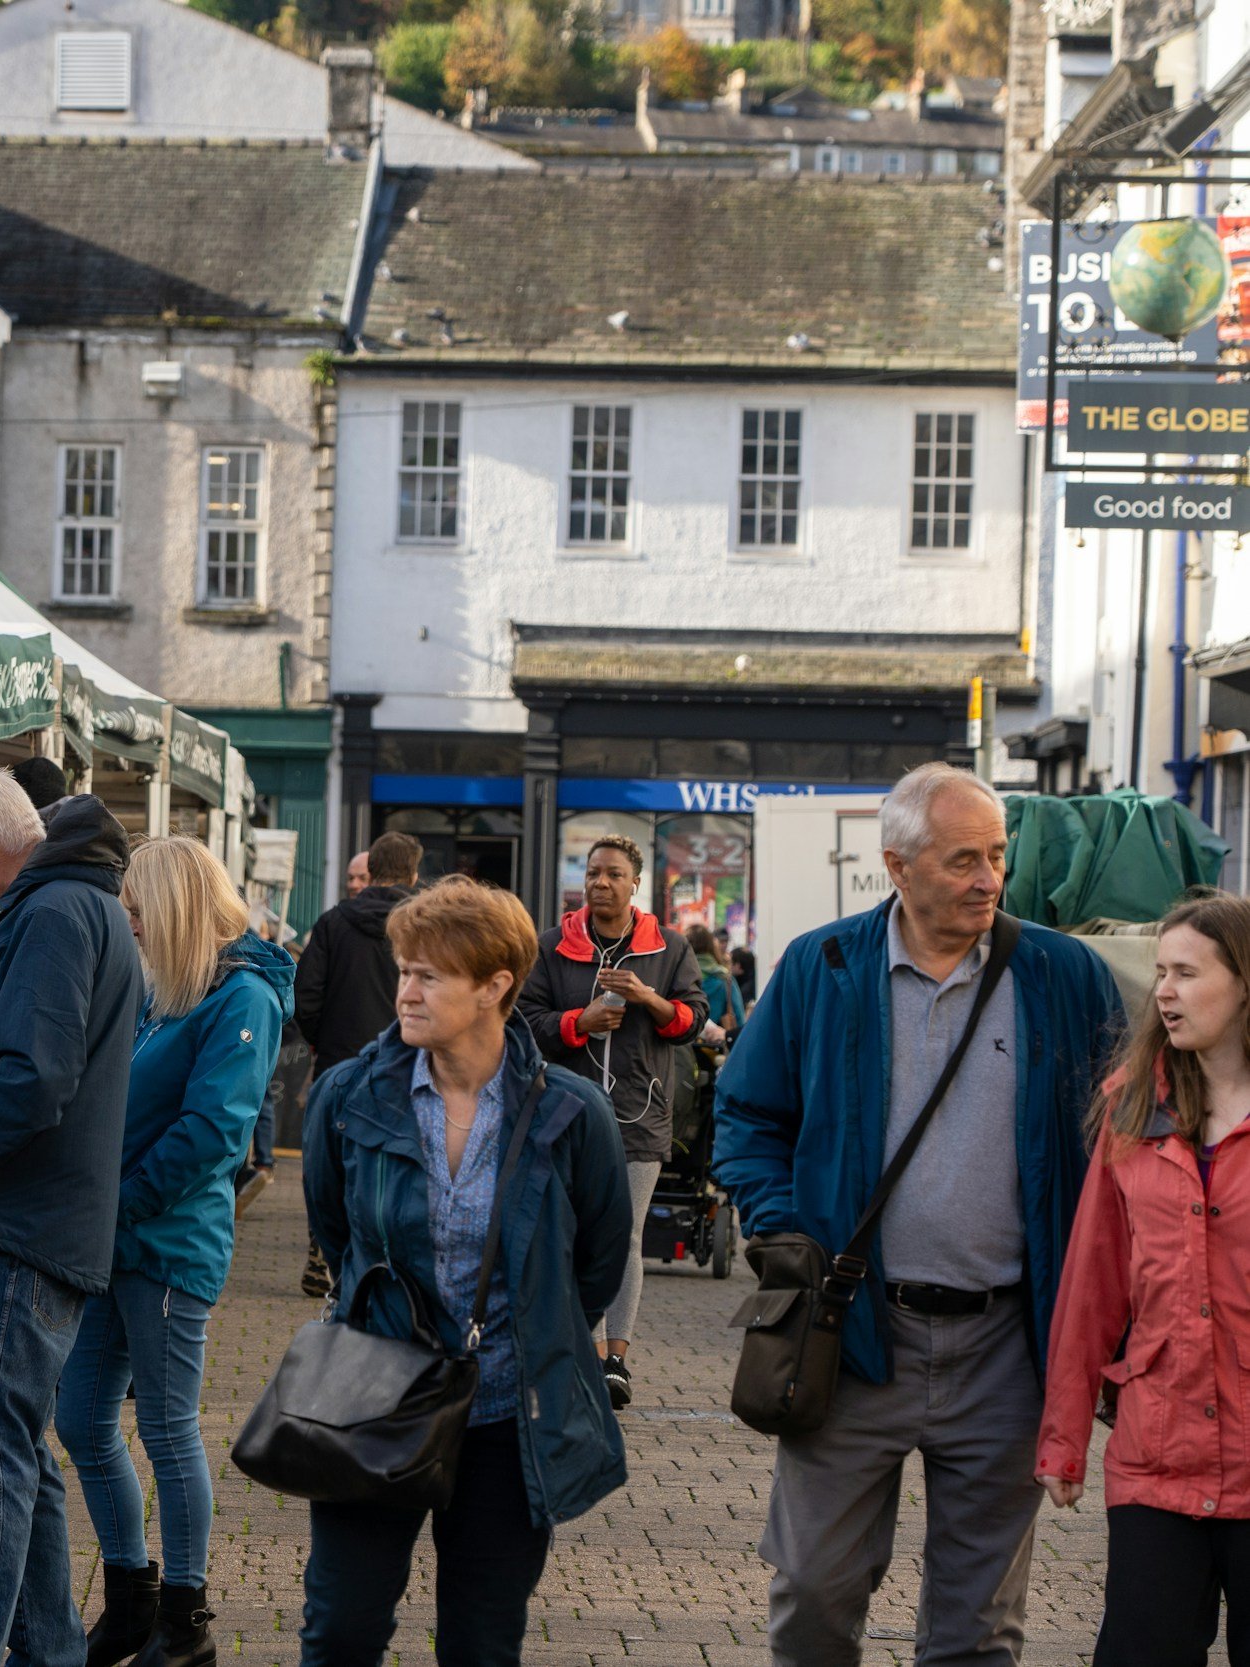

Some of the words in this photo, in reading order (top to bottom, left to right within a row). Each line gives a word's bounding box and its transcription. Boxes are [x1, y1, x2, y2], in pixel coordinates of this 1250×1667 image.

[1082, 406, 1140, 431] THE
[1146, 406, 1249, 432] GLOBE
[1093, 494, 1165, 519] Good
[1172, 495, 1232, 520] food
[687, 836, 709, 865] 3
[723, 837, 745, 867] 2
[852, 873, 894, 893] Mil
